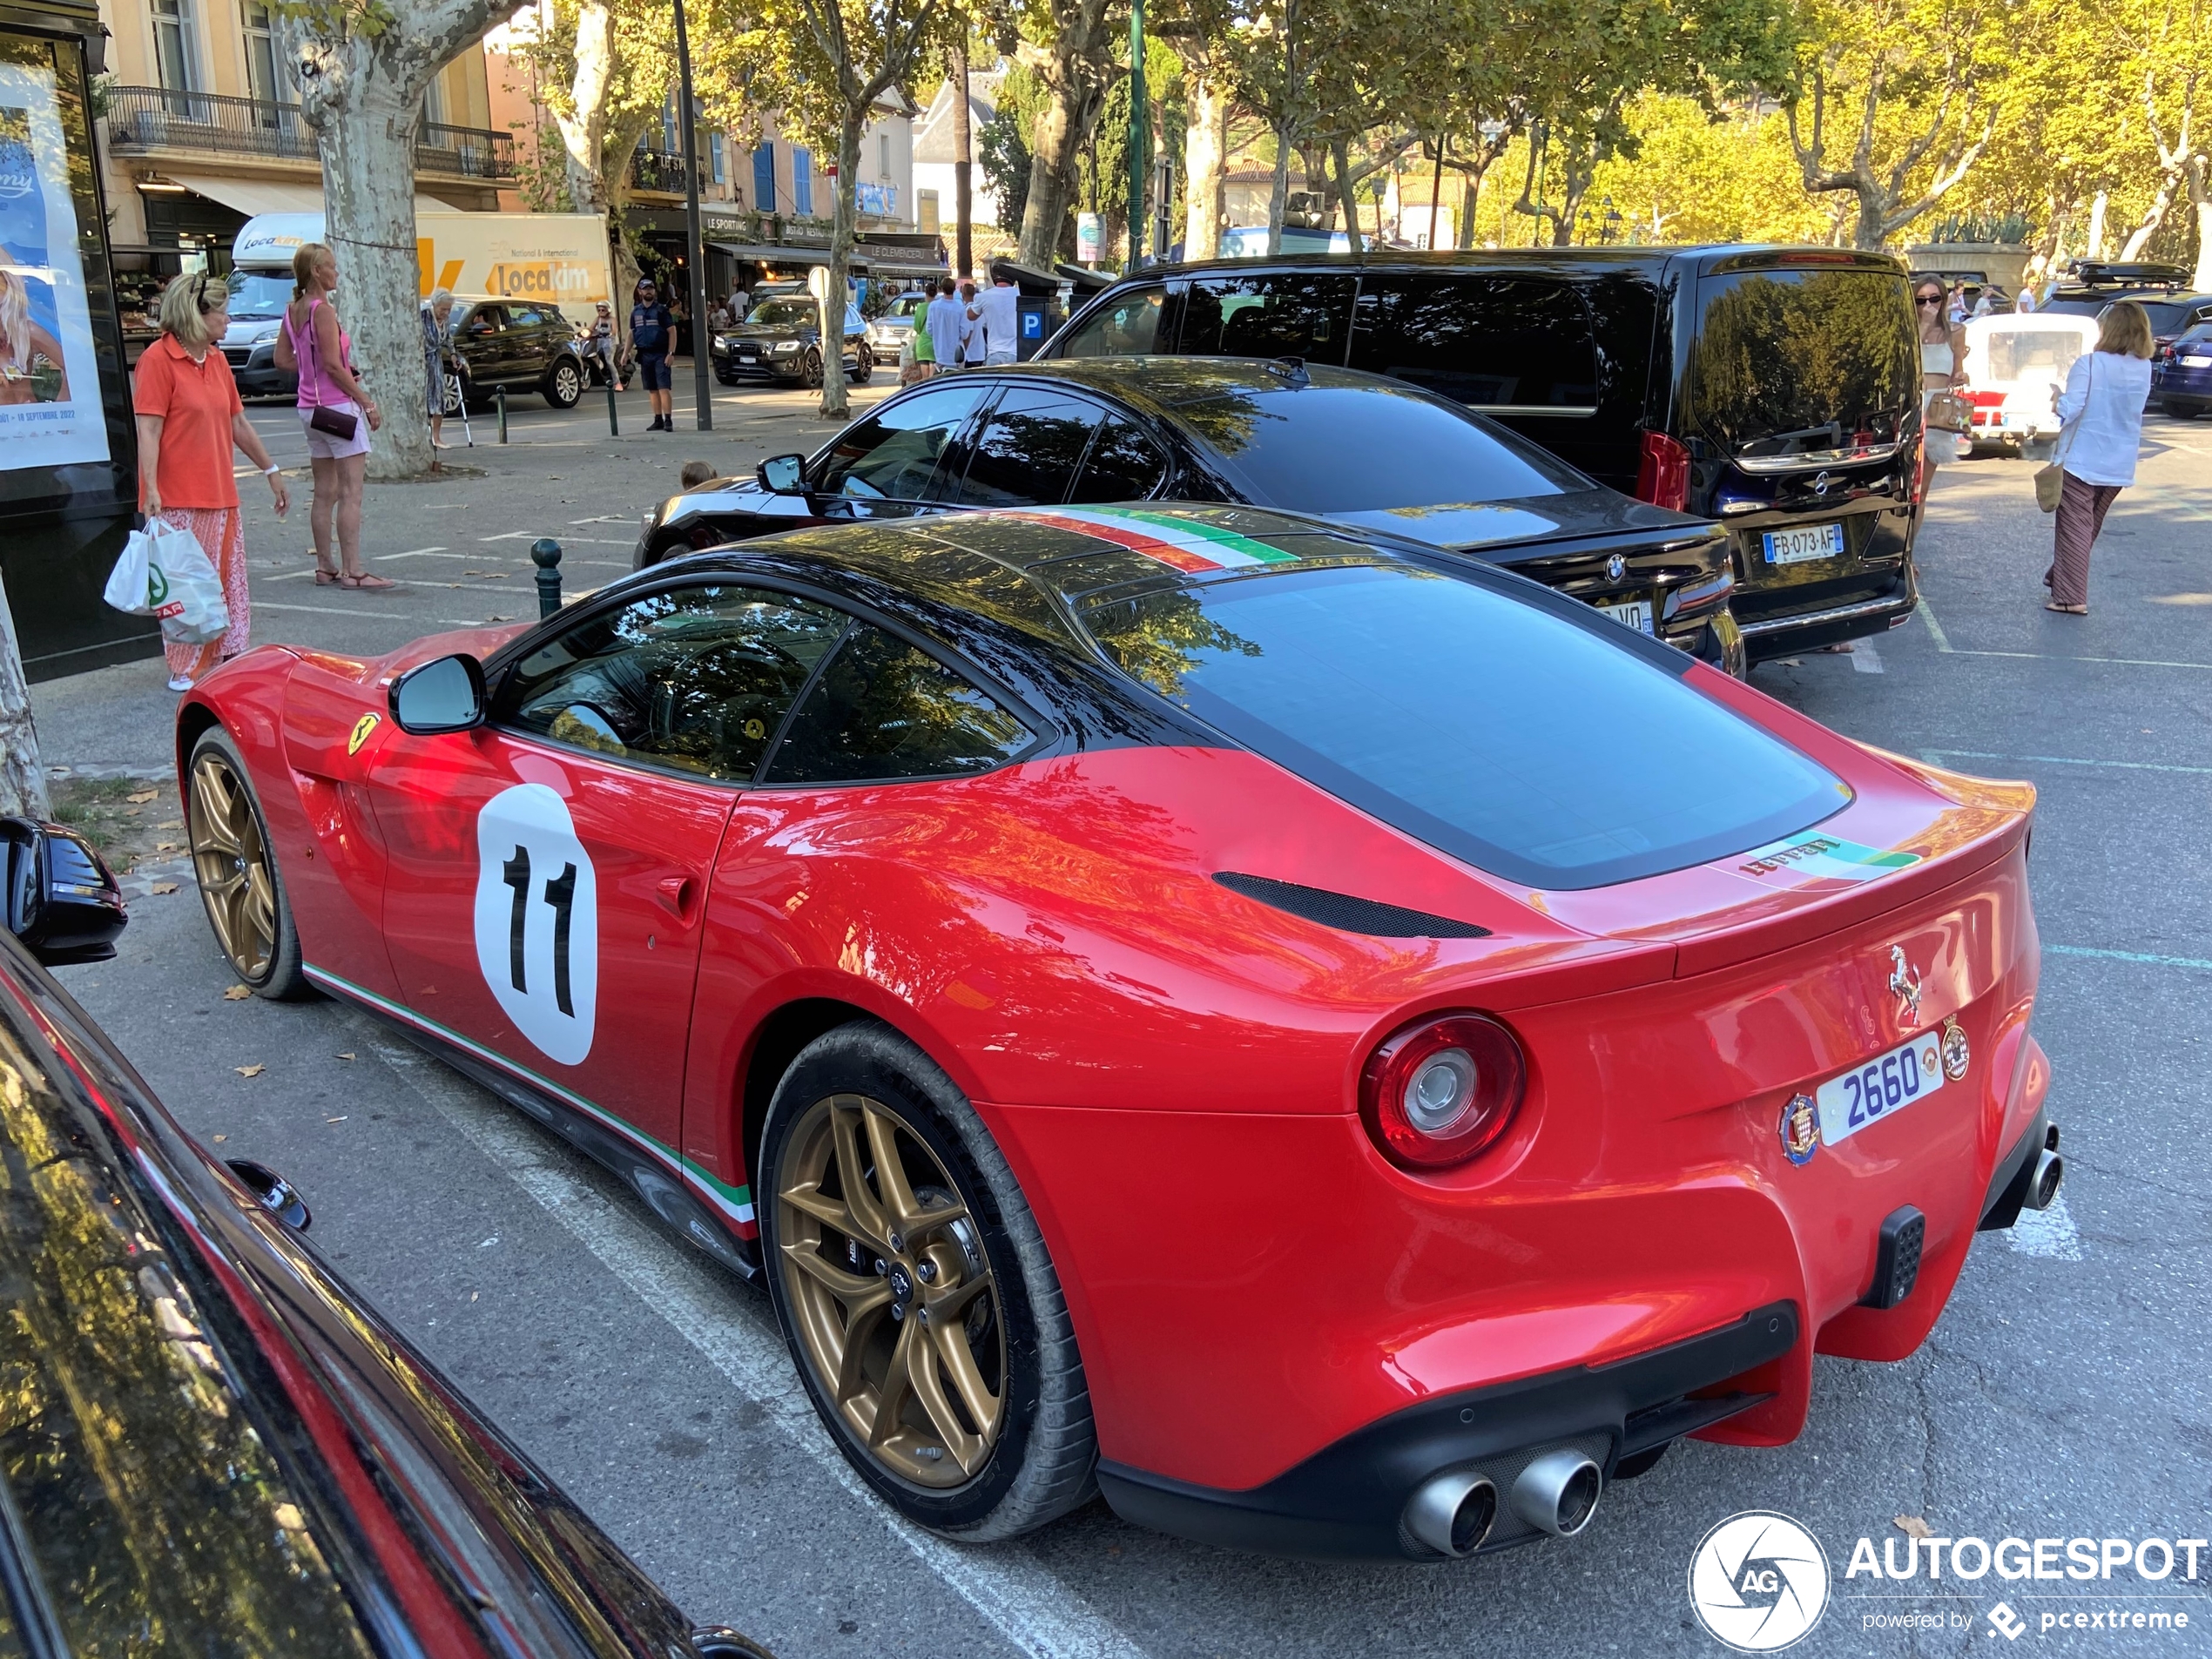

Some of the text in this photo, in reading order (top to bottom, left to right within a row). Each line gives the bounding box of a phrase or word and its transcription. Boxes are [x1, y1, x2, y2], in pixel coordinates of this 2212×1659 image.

[707, 218, 746, 231] LE SPORTING
[543, 248, 579, 257] International
[872, 247, 925, 260] LE CLEMENCEAU
[497, 262, 590, 297] Locakim
[1024, 314, 1039, 335] P
[17, 413, 24, 421] 18
[25, 410, 58, 421] SEPTEMBRE
[59, 409, 76, 419] 2022
[1738, 837, 1841, 877] Ferrari
[502, 843, 577, 1019] 11
[1843, 1047, 1919, 1129] 2660
